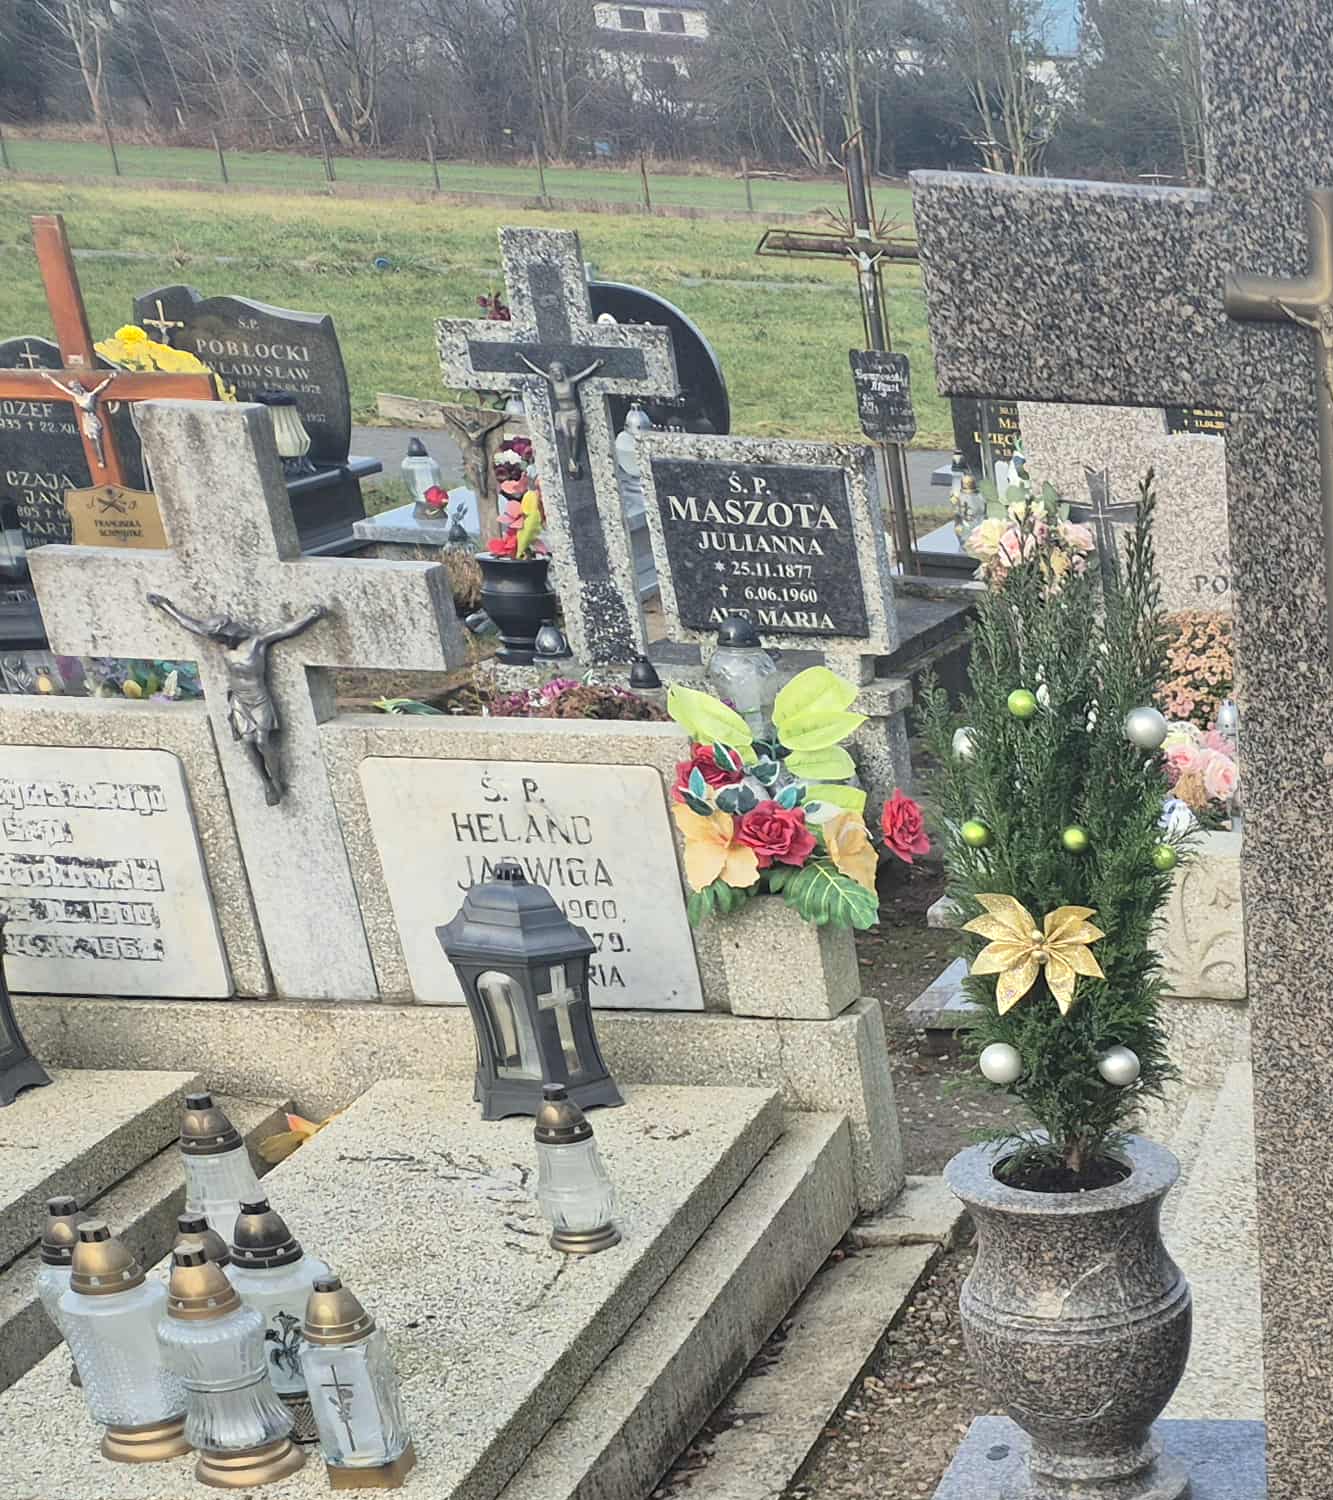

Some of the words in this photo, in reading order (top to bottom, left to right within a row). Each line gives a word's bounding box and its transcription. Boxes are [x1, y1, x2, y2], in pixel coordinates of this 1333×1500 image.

[6, 470, 78, 489] CZAJA
[667, 495, 838, 529] MASZOTA
[699, 531, 824, 555] JULIANNA
[731, 561, 812, 579] 25.11.1877
[744, 586, 817, 603] 6.06.1960
[758, 609, 835, 629] MARIA
[451, 812, 592, 845] HELAND
[457, 856, 613, 891] JAWIGA
